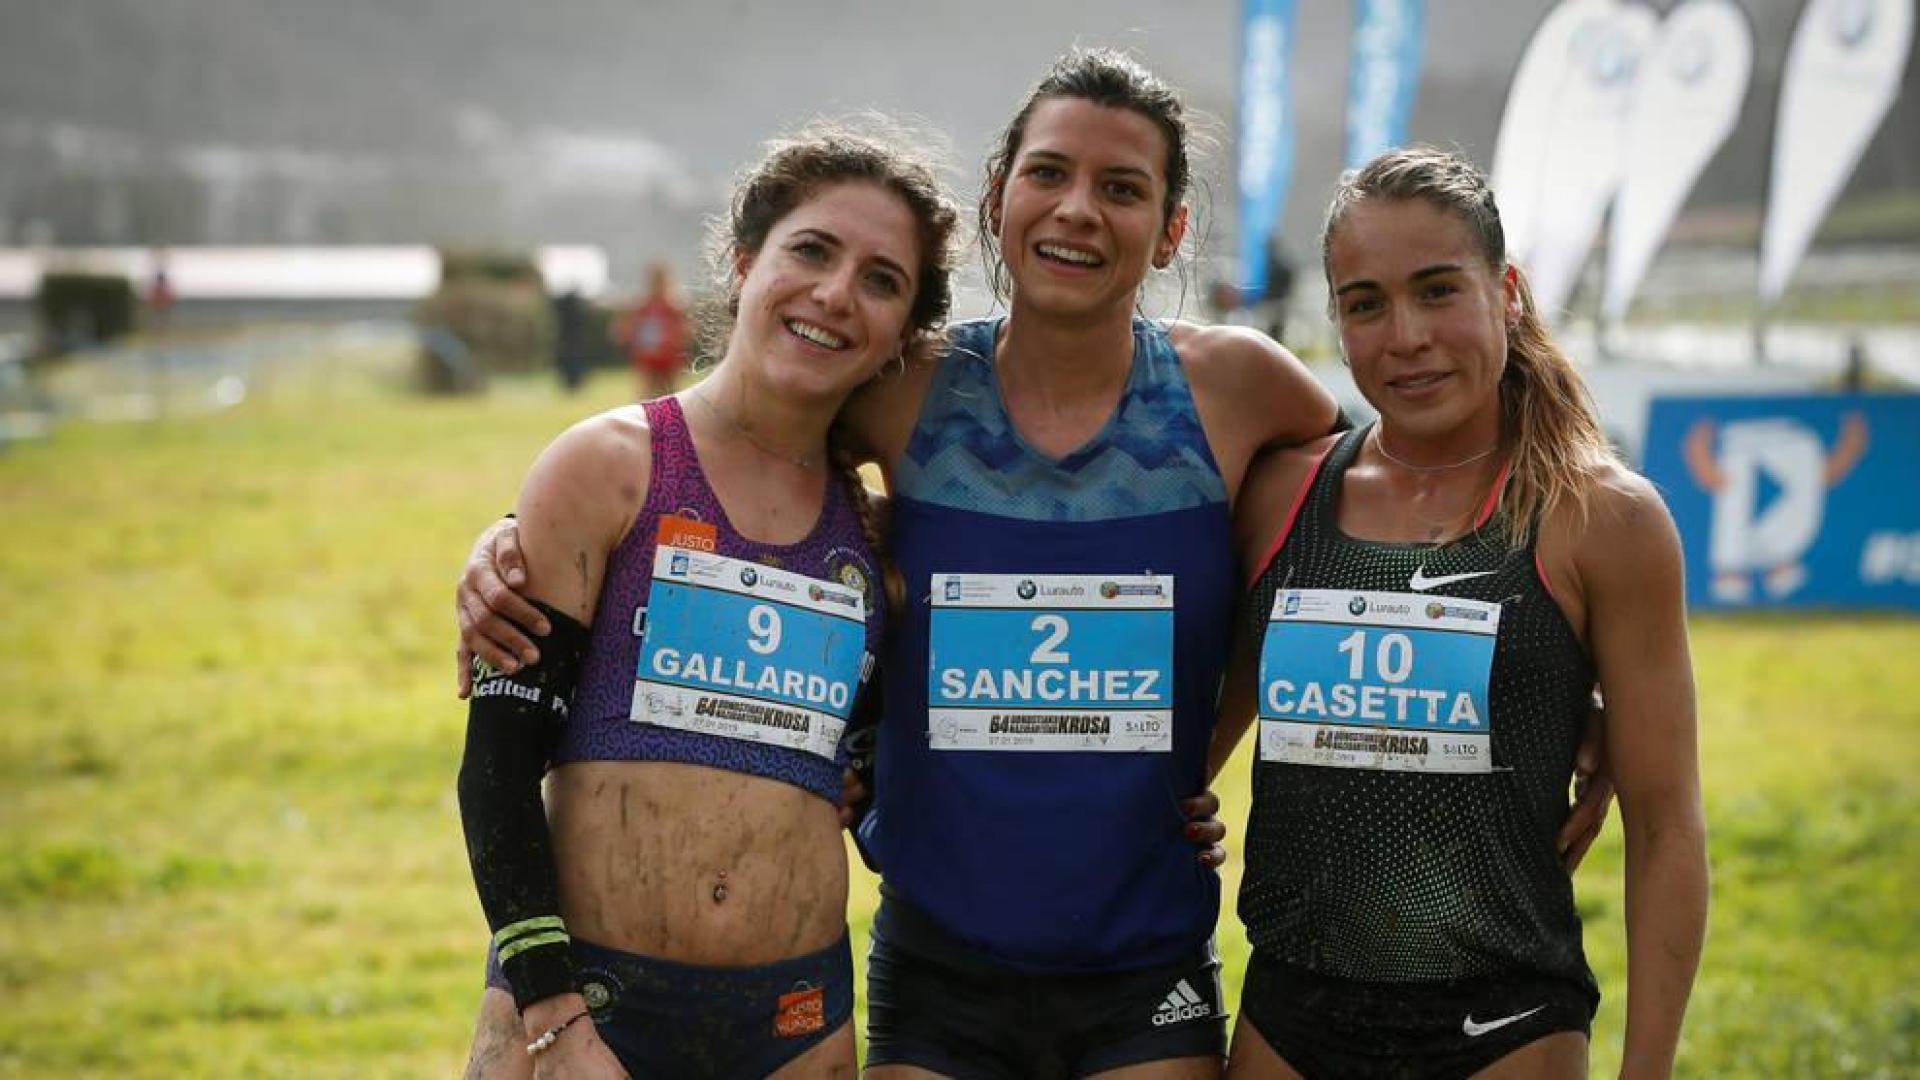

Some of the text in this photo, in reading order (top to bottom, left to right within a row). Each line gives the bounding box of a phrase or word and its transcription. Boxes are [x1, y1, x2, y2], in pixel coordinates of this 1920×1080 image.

[669, 532, 715, 551] JUSTO
[1040, 582, 1085, 596] Lurauto
[747, 604, 783, 655] 9
[1029, 614, 1070, 664] 2
[1338, 630, 1413, 684] 10
[652, 646, 849, 708] GALLARDO
[941, 668, 1161, 701] SANCHEZ
[1268, 680, 1480, 726] CASETTA
[762, 708, 810, 733] KROSA
[989, 715, 1010, 734] 64
[1058, 715, 1110, 734] KROSA
[1379, 736, 1429, 755] KROSA
[1151, 1002, 1211, 1026] adidas
